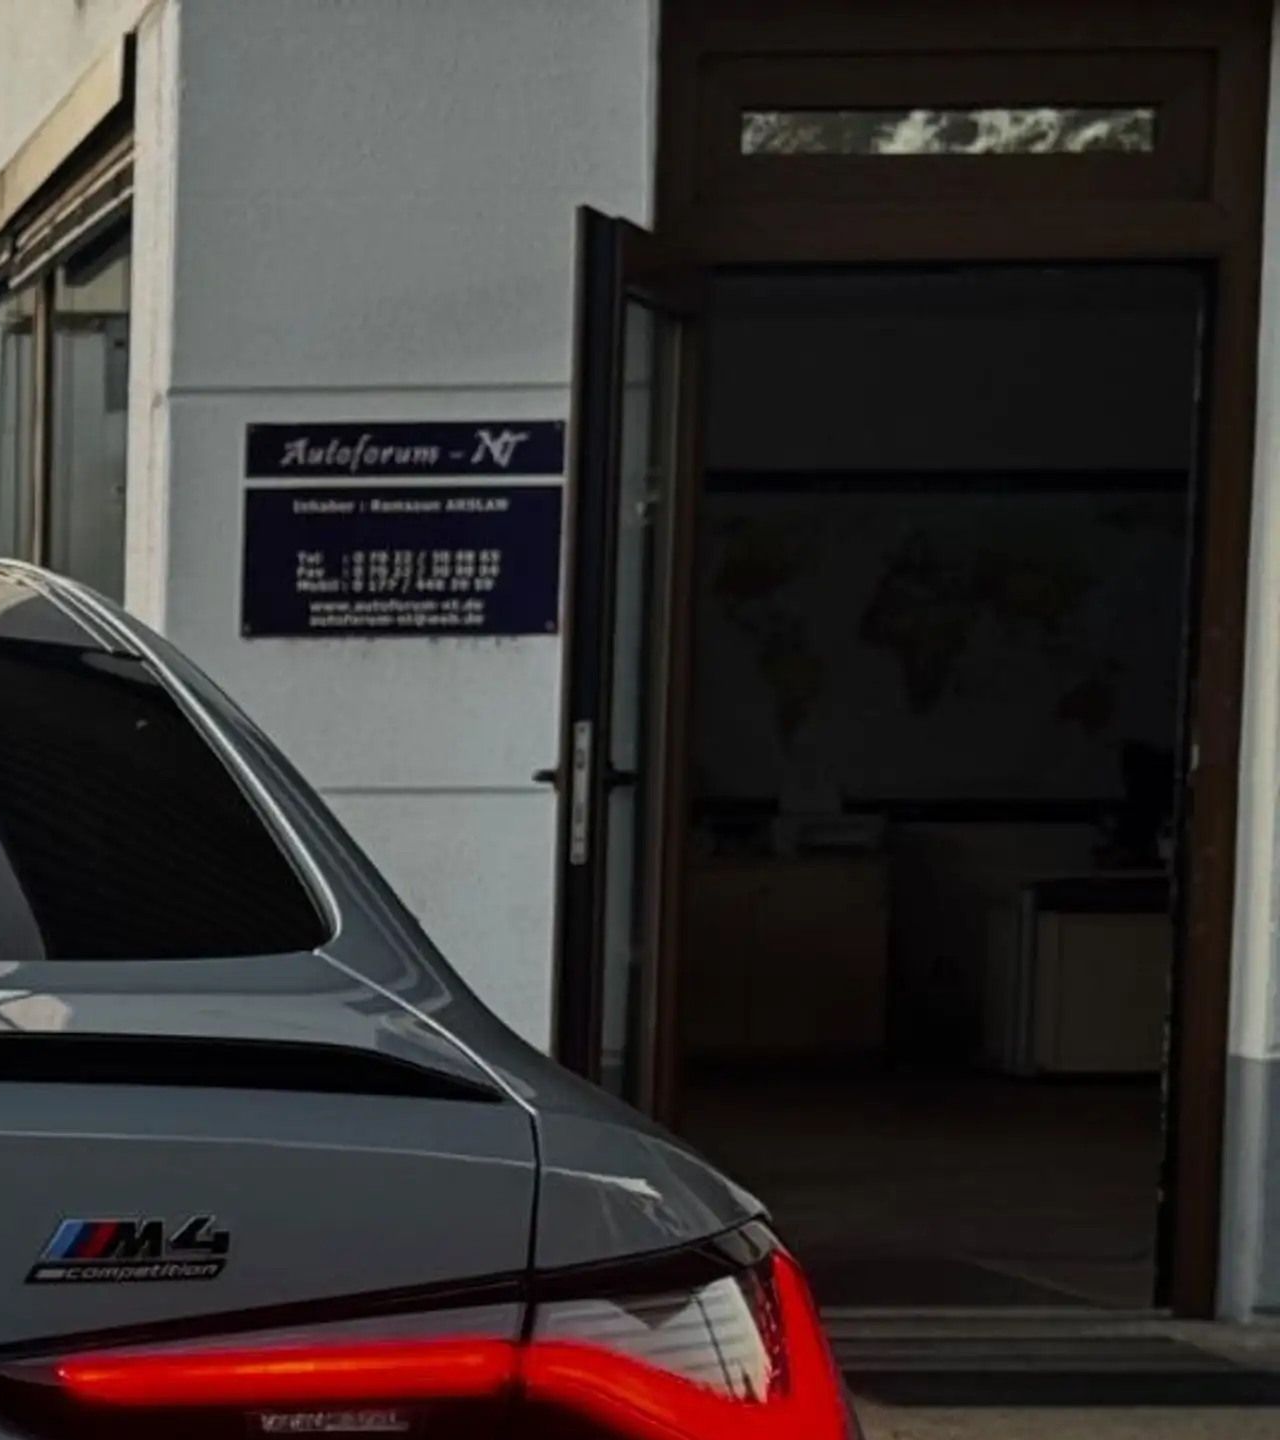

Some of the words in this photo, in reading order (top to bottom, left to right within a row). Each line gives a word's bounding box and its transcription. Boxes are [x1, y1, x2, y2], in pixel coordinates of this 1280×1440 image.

[280, 434, 439, 474] Autoforum
[471, 430, 530, 468] NT
[97, 1214, 230, 1259] M4
[65, 1263, 219, 1281] competition
